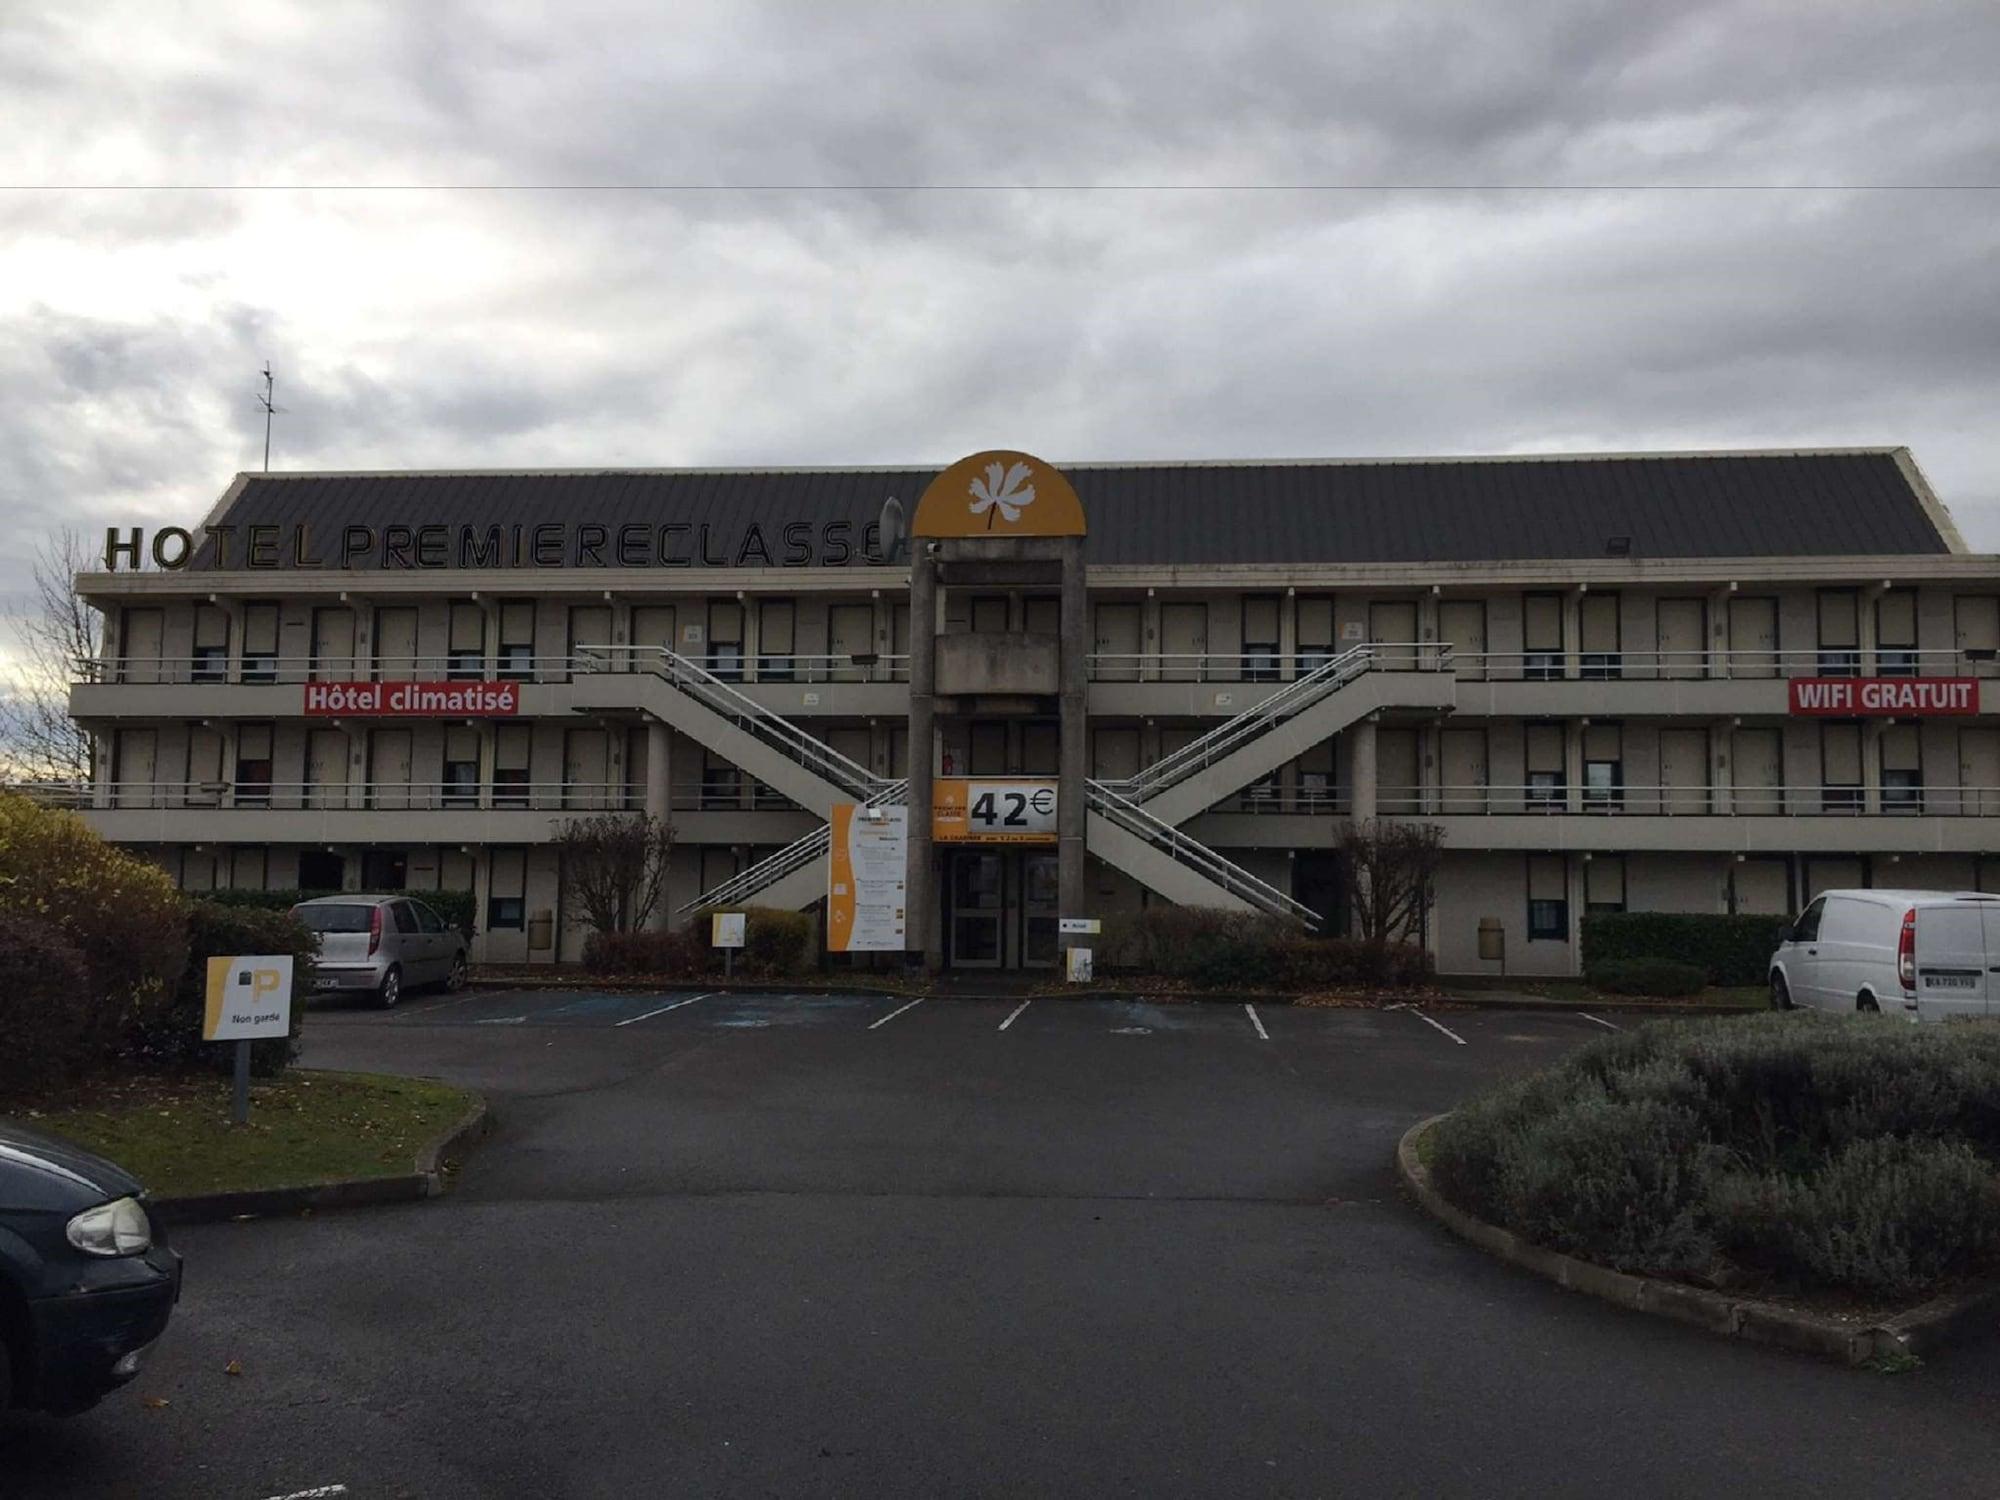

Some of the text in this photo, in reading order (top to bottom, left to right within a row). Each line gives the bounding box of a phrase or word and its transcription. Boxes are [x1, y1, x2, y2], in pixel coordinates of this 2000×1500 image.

[106, 524, 322, 570] HOTEL
[308, 684, 514, 711] Hôtel climatisé
[1797, 683, 1972, 709] WIFI GRATUIT
[252, 969, 281, 1003] P
[232, 1014, 252, 1024] Non
